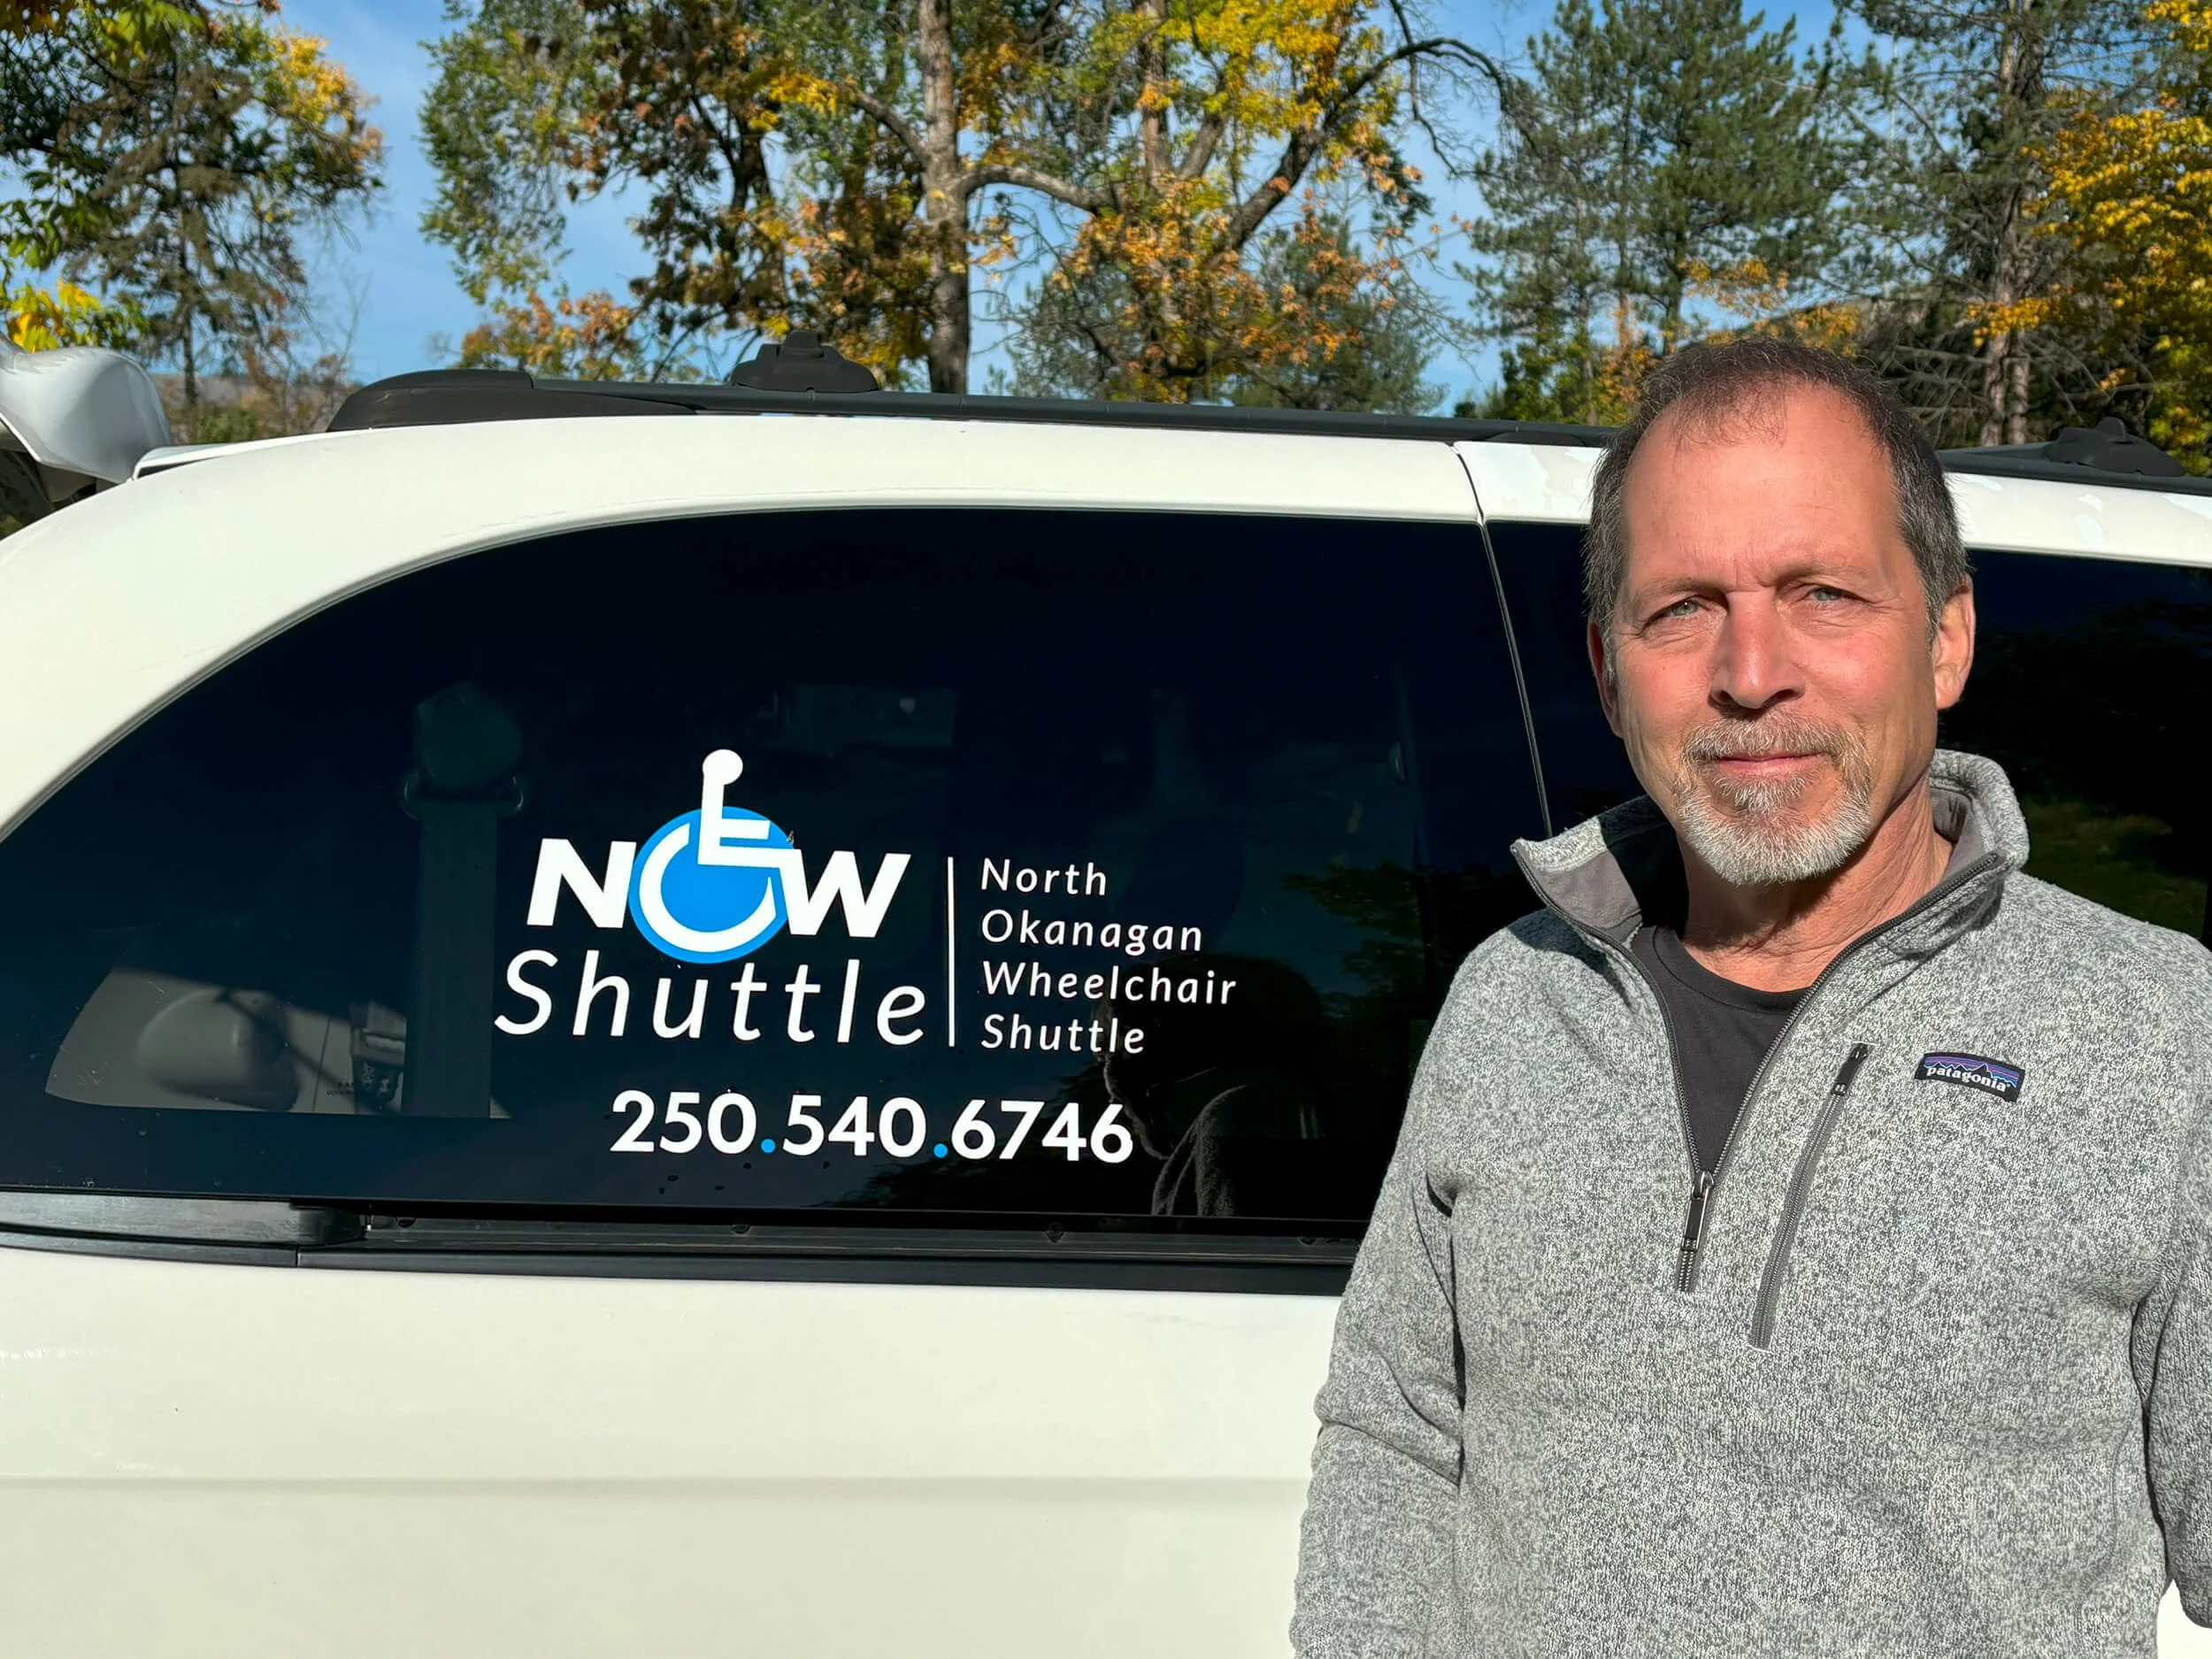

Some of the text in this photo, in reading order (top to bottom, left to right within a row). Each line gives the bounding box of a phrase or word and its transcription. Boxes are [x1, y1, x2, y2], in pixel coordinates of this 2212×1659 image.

[981, 857, 1106, 895] North
[982, 909, 1202, 956] Okanagan
[494, 949, 926, 1045] Shuttle
[983, 961, 1236, 1004] Wheelchair
[981, 1013, 1144, 1054] Shuttle
[610, 1089, 1133, 1164] 250.540.6746
